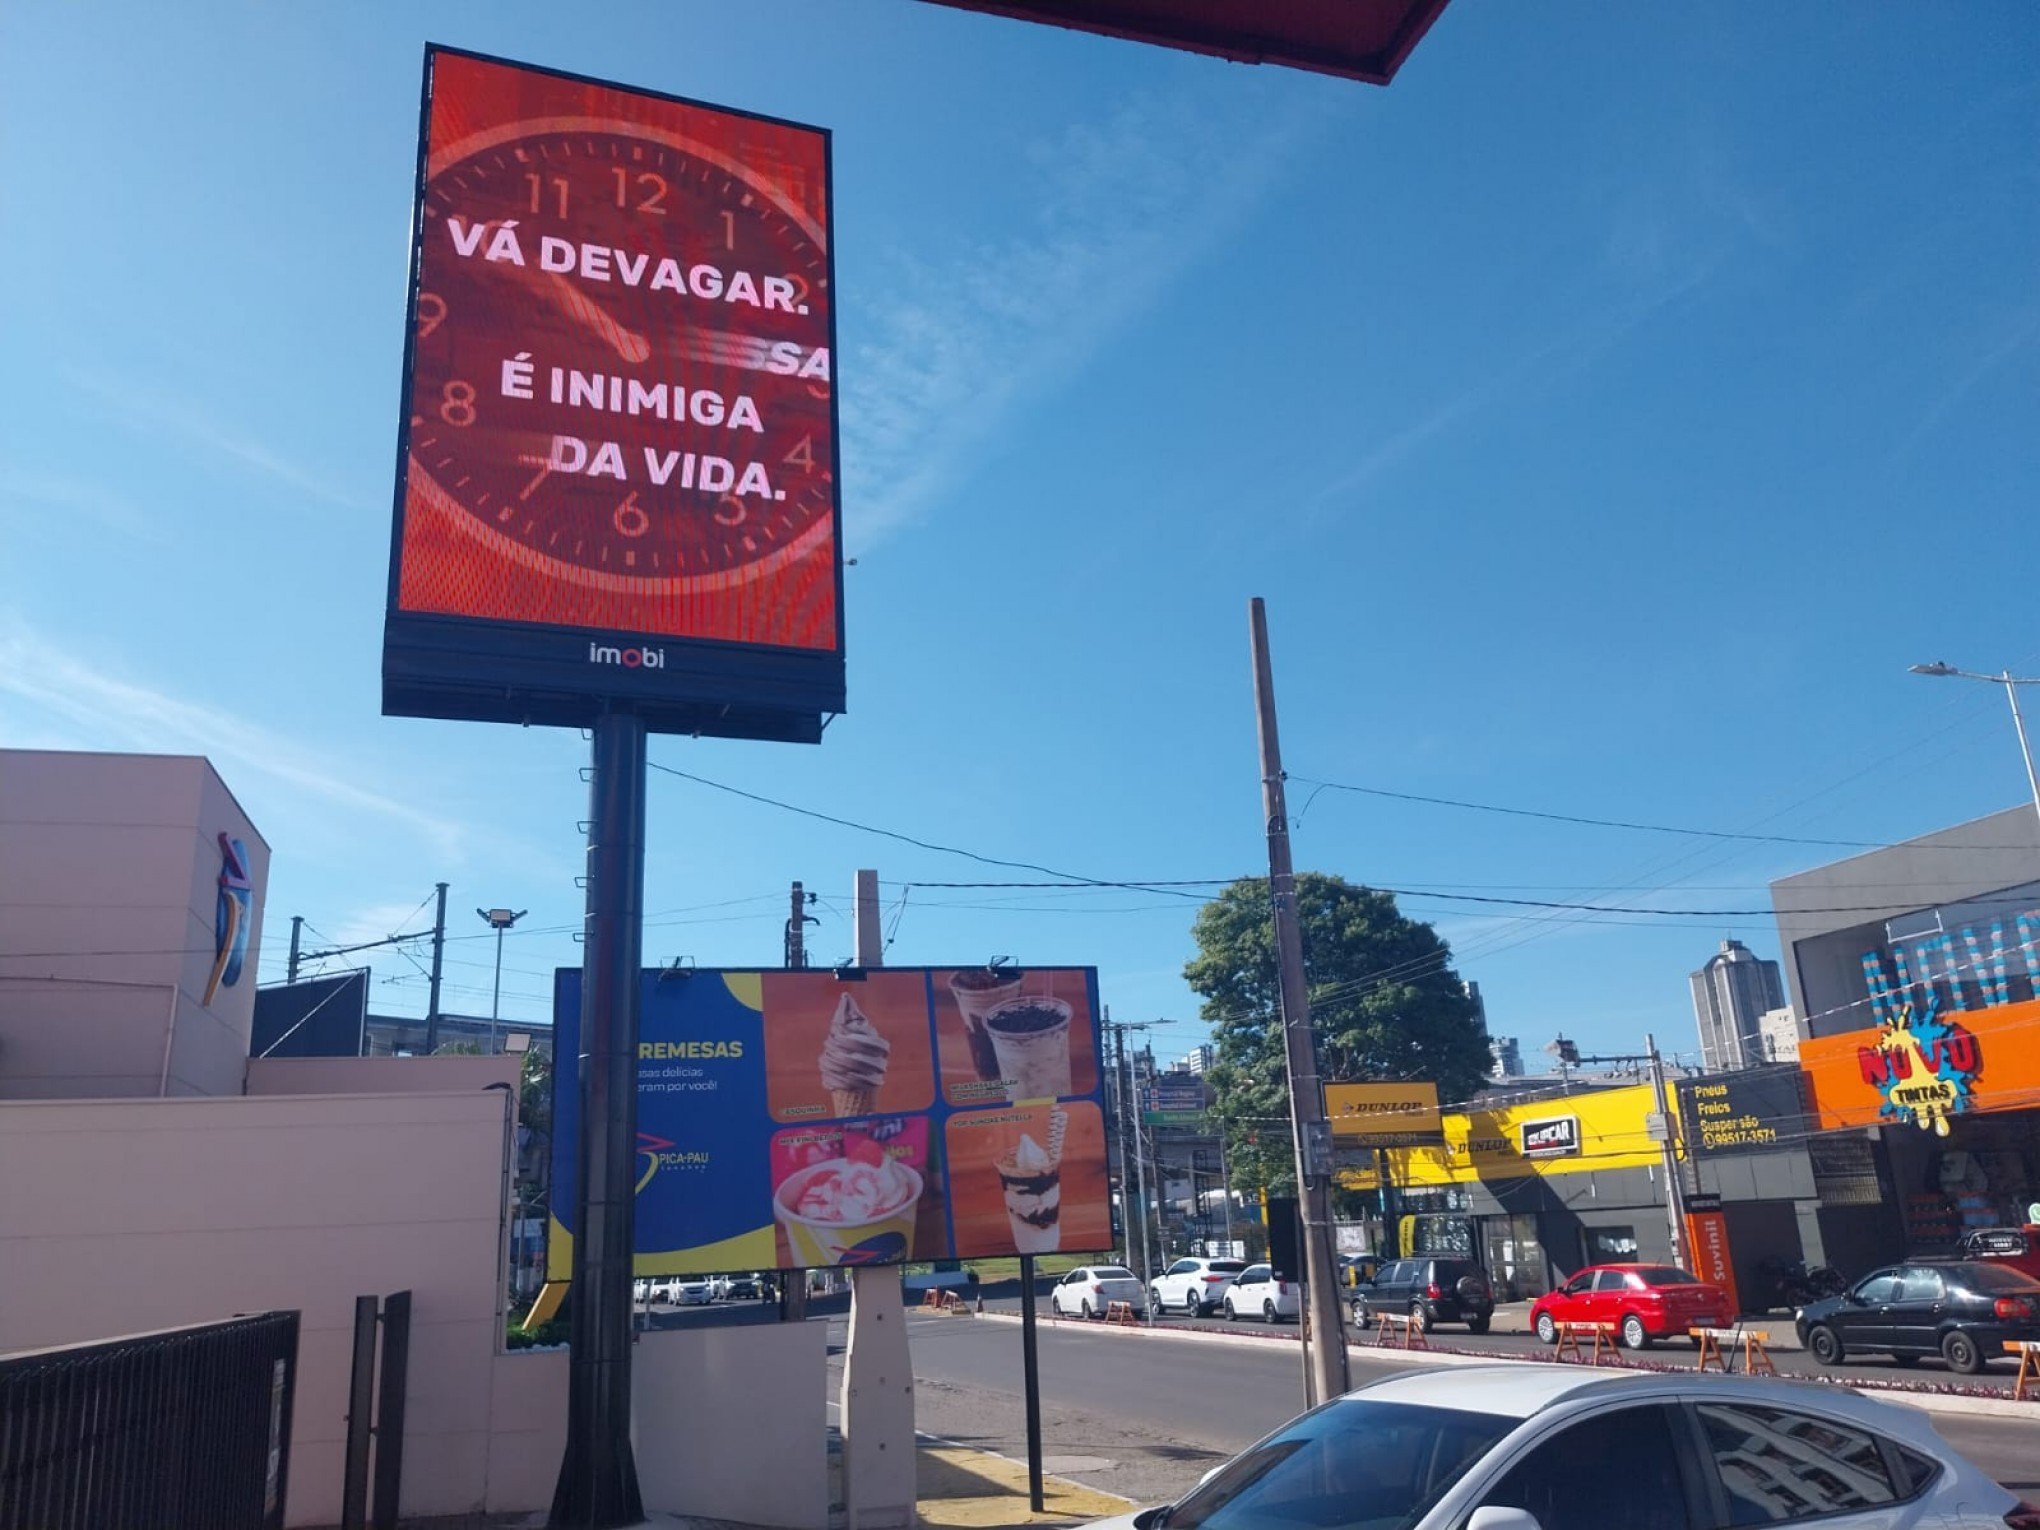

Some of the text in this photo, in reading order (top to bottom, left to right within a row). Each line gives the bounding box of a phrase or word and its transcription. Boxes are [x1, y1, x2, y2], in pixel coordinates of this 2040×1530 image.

[524, 172, 569, 219] 11
[611, 166, 668, 215] 12
[720, 209, 735, 250] 1
[447, 218, 525, 266] VÁ
[541, 235, 809, 314] DEVAGAR.
[440, 380, 476, 427] 8
[501, 352, 764, 433] É INIMIGA
[549, 435, 786, 501] DA VIDA.
[783, 434, 816, 475] 4
[518, 452, 554, 500] 7
[613, 490, 649, 537] 6
[590, 642, 664, 668] imobi
[638, 1041, 744, 1059] REMESAS
[667, 1083, 686, 1093] por
[688, 1079, 718, 1091] você!
[1694, 1085, 1728, 1098] Pneus
[1895, 1084, 1951, 1103] TINTAS
[1356, 1102, 1423, 1112] DUNLOP
[1697, 1101, 1731, 1115] Freios
[658, 1152, 710, 1164] PICA-PAU
[1704, 1219, 1726, 1280] Suvinil
